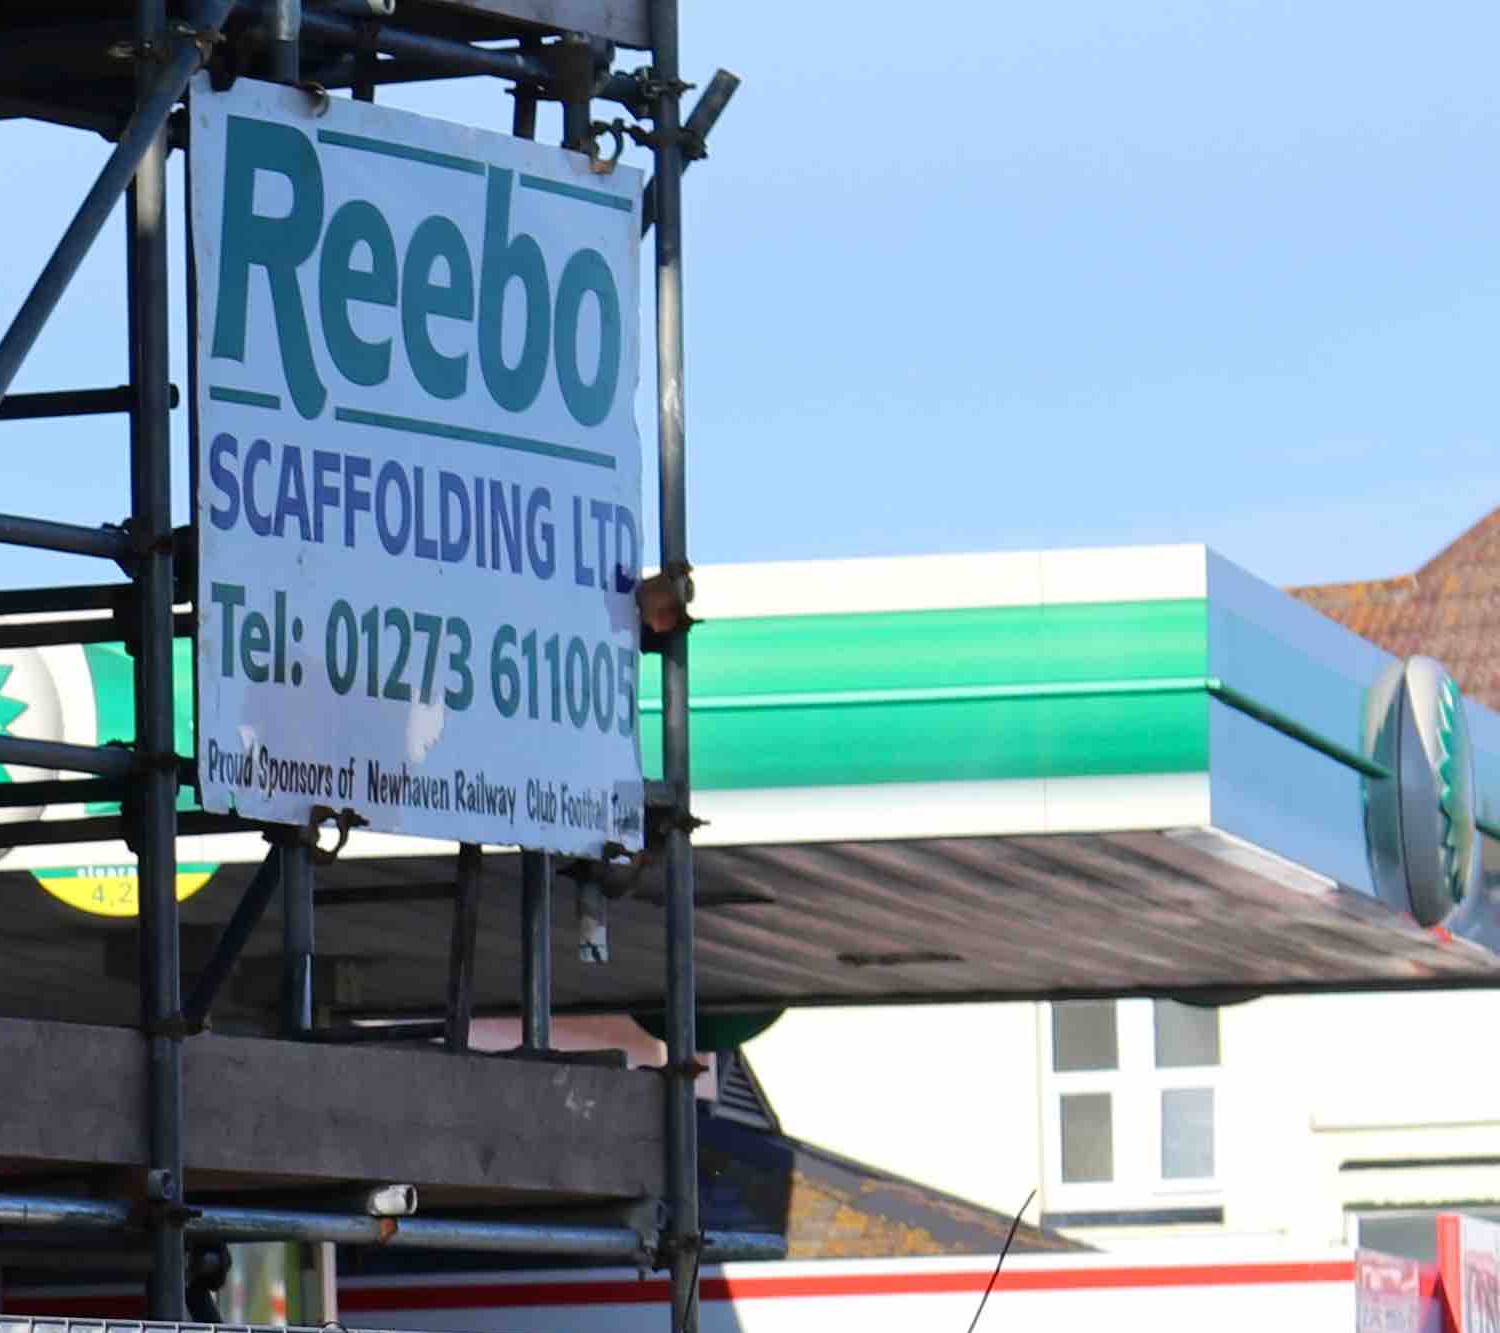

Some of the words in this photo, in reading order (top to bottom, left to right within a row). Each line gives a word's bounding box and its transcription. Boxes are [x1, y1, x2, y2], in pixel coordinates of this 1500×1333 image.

[211, 113, 621, 427] Reebo
[209, 431, 556, 580] SCAFFOLDING
[572, 495, 637, 594] LTD
[211, 581, 304, 688] Tel:
[325, 598, 475, 712] 01273
[490, 623, 635, 737] 611005
[208, 737, 252, 788] Proud
[258, 745, 333, 798] Sponsors
[338, 756, 356, 799] of
[367, 759, 450, 812] Newhaven
[454, 768, 517, 825] Railway
[523, 777, 557, 824] Club
